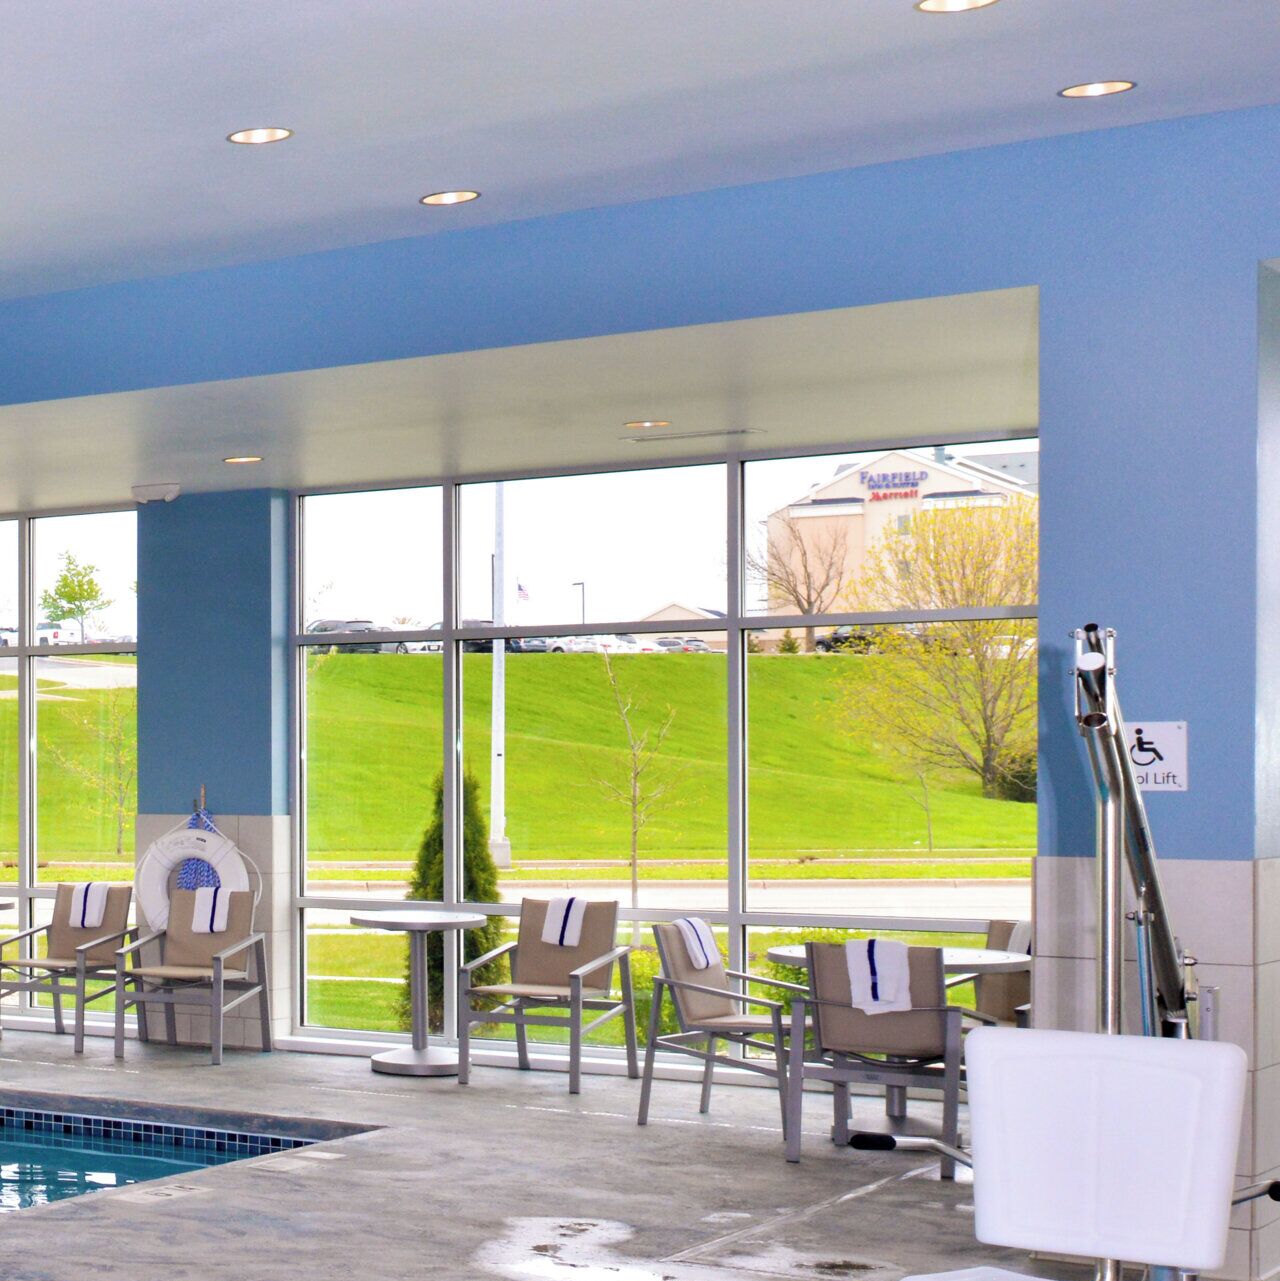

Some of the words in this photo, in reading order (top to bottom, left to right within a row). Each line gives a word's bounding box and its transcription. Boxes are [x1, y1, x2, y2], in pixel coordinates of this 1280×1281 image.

[860, 471, 928, 484] FAIRFIELD
[869, 489, 918, 502] Marriott
[1153, 772, 1177, 784] Lift
